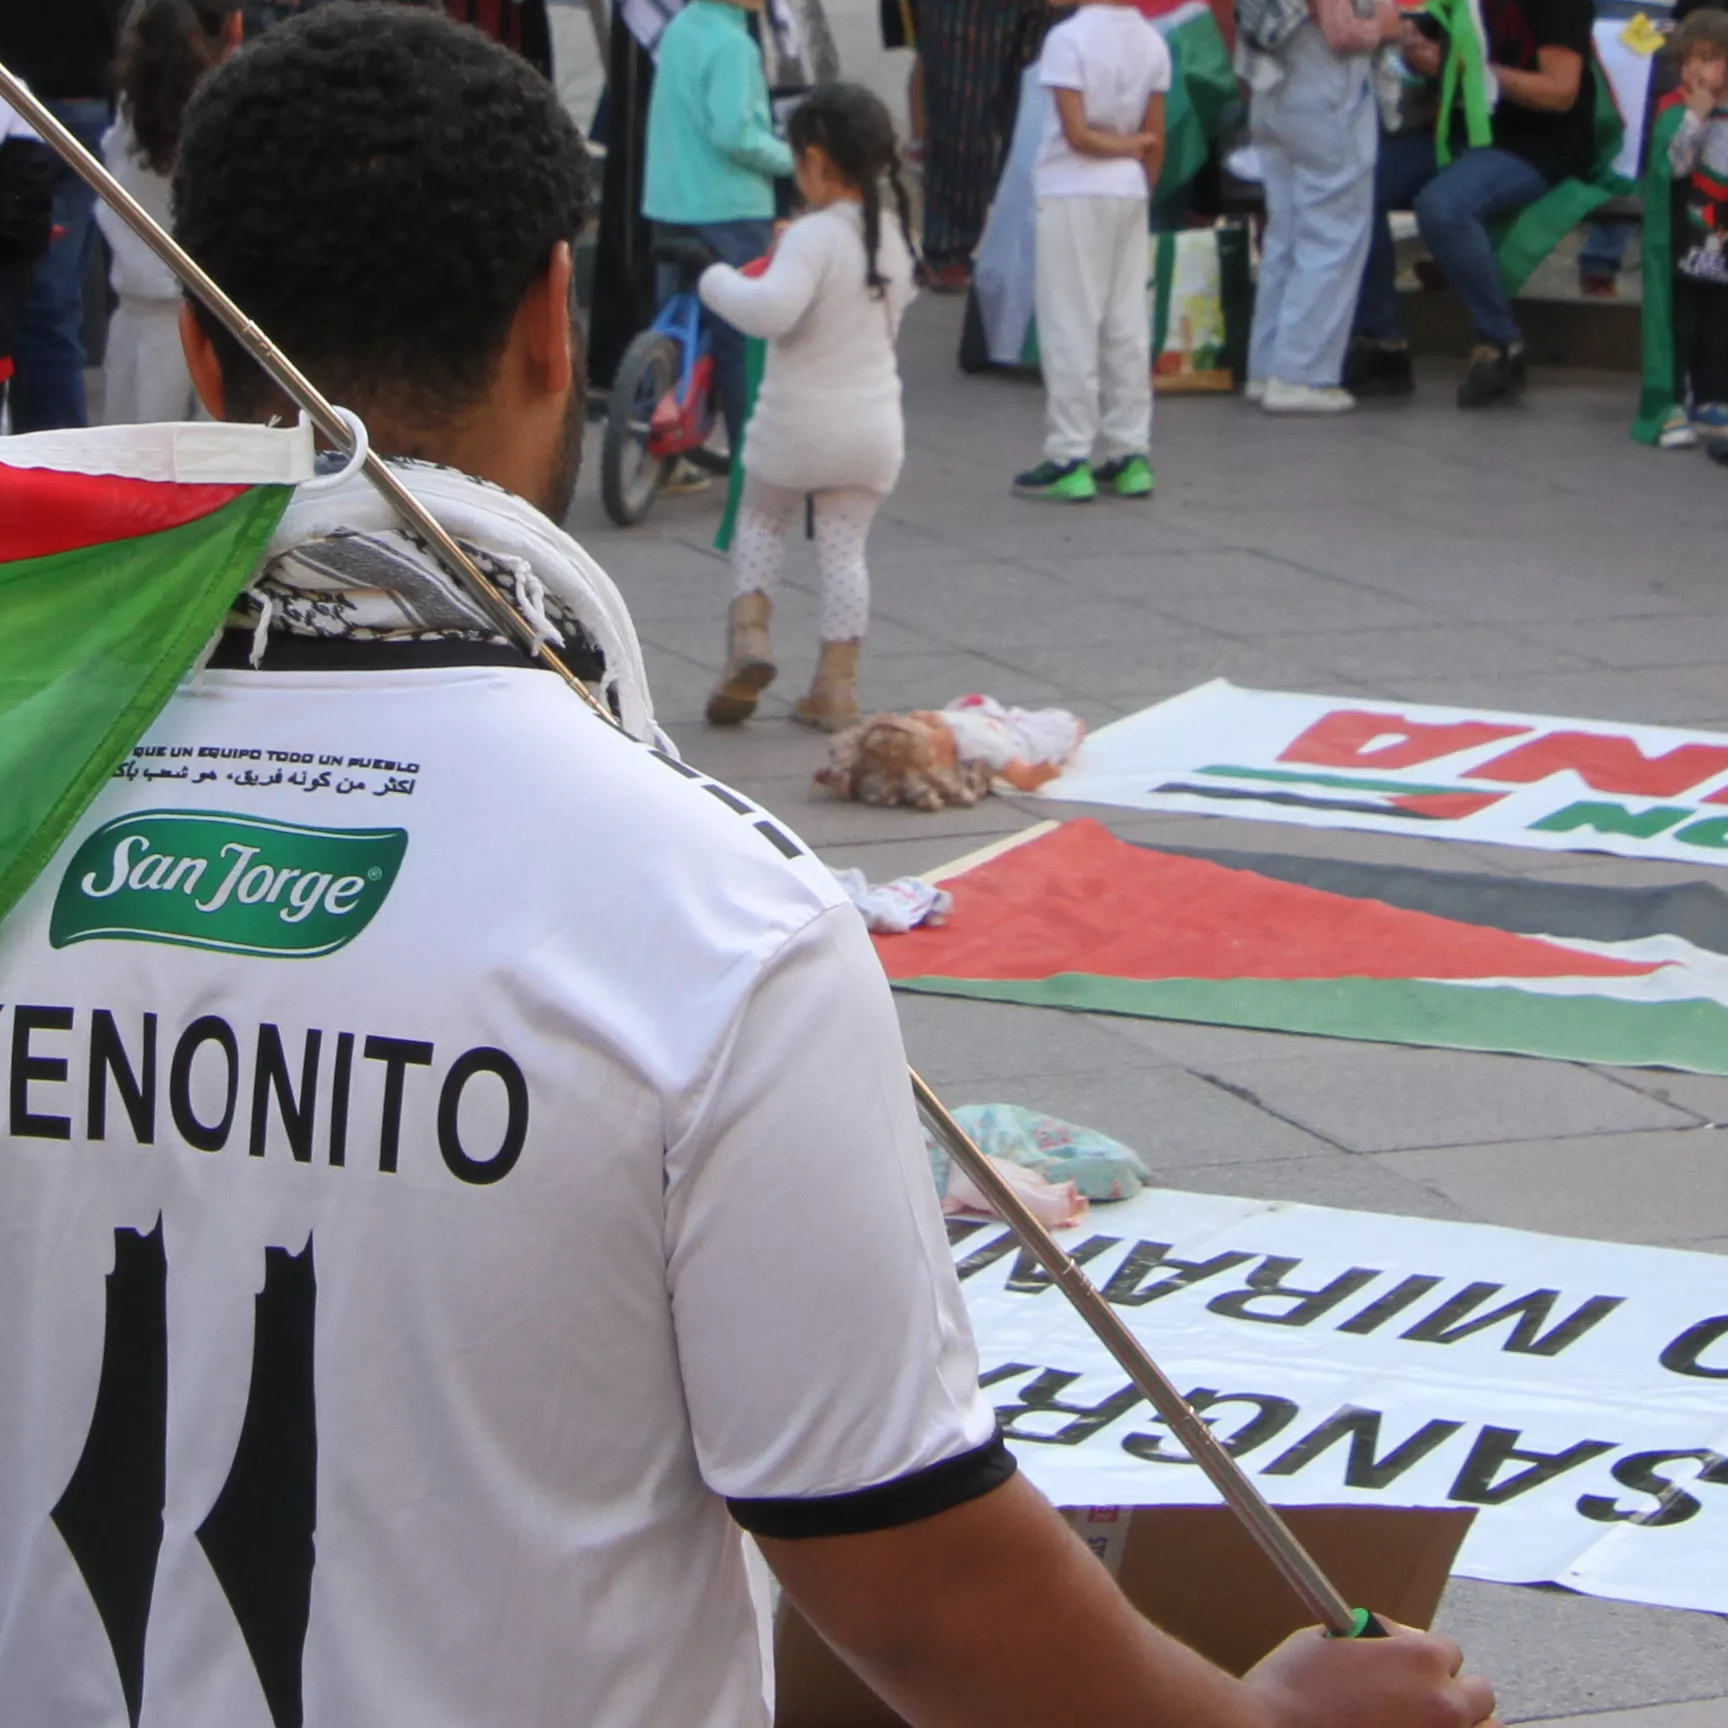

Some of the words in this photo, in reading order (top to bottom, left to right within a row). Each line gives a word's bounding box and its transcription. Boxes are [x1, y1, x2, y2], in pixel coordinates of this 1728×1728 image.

[132, 746, 167, 757] QUE
[170, 747, 193, 758] UN
[198, 747, 262, 760] EQUIPO
[267, 750, 314, 765] TODO
[318, 754, 344, 767] UN
[348, 757, 421, 774] PUEBLO
[81, 835, 208, 899] San
[194, 842, 365, 923] Jorge
